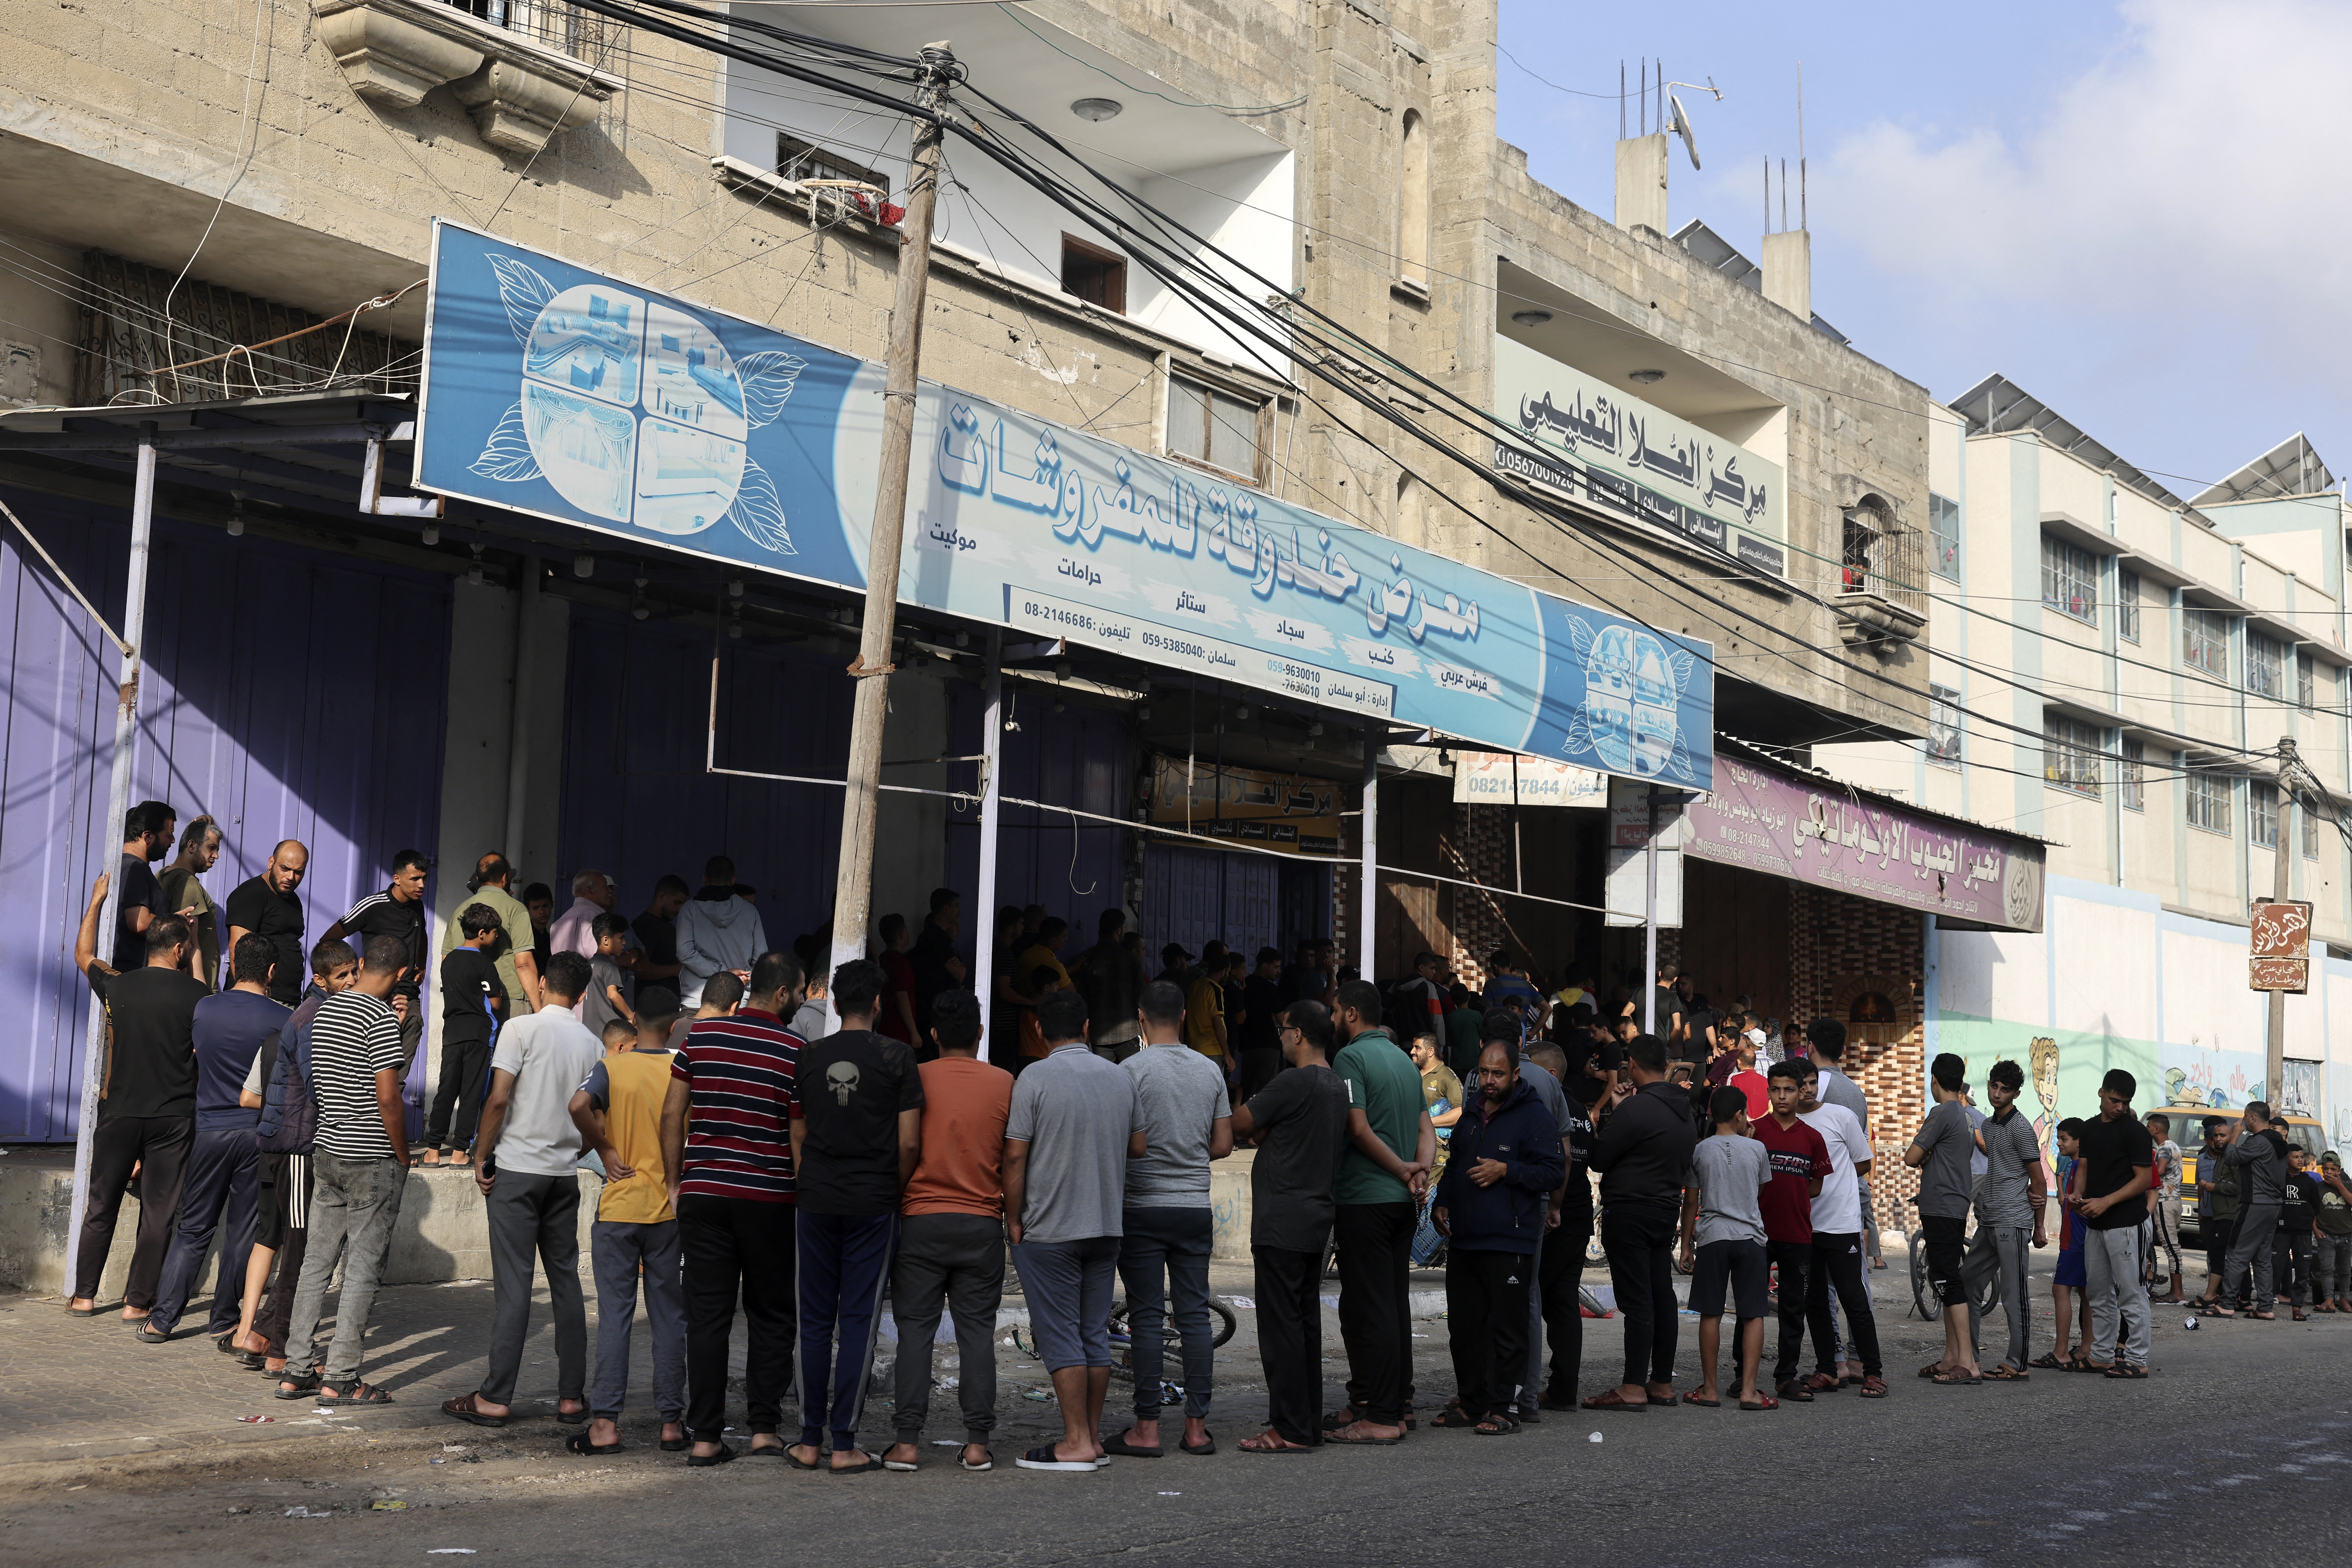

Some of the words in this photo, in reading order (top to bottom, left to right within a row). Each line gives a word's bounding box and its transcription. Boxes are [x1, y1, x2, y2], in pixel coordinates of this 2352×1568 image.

[1519, 386, 1623, 457] التعليمي
[938, 403, 1199, 554] للمفروشات
[1507, 451, 1573, 490] 0567001926
[1703, 444, 1766, 524] مركز
[930, 523, 976, 550] موكيت
[1058, 558, 1101, 585] حرامات
[1176, 591, 1206, 614] ستائر
[1367, 551, 1479, 640] معرض
[1025, 602, 1092, 630] 08-2146686
[1277, 621, 1304, 641] سجاد
[1143, 633, 1203, 658] 059-5385040
[1369, 648, 1394, 665] كنب
[1267, 659, 1320, 683] 059-9630010
[1441, 671, 1464, 686] عربي
[1466, 670, 1488, 692] فرش
[1328, 683, 1352, 699] سلمان
[1355, 686, 1366, 704] أبو
[1470, 777, 1559, 795] 082147844
[1731, 766, 1752, 786] الحاج
[1282, 777, 1331, 819] مركز
[1729, 797, 1749, 825] يونس
[1749, 800, 1761, 827] أبو
[1762, 805, 1775, 831] زياد
[1776, 808, 1786, 834] أبو
[1212, 821, 1232, 833] ثانوي
[1728, 828, 1770, 851] 08-2147844
[1704, 840, 1746, 863] 0599852648
[1753, 852, 1792, 874] 0599737680
[1911, 831, 1964, 883] الجنوب
[1963, 839, 2000, 892] مخبز
[1952, 896, 1965, 913] أجود
[2260, 965, 2276, 975] عفتي
[2263, 974, 2296, 985] وطهارتي
[2275, 965, 2295, 975] حجابي
